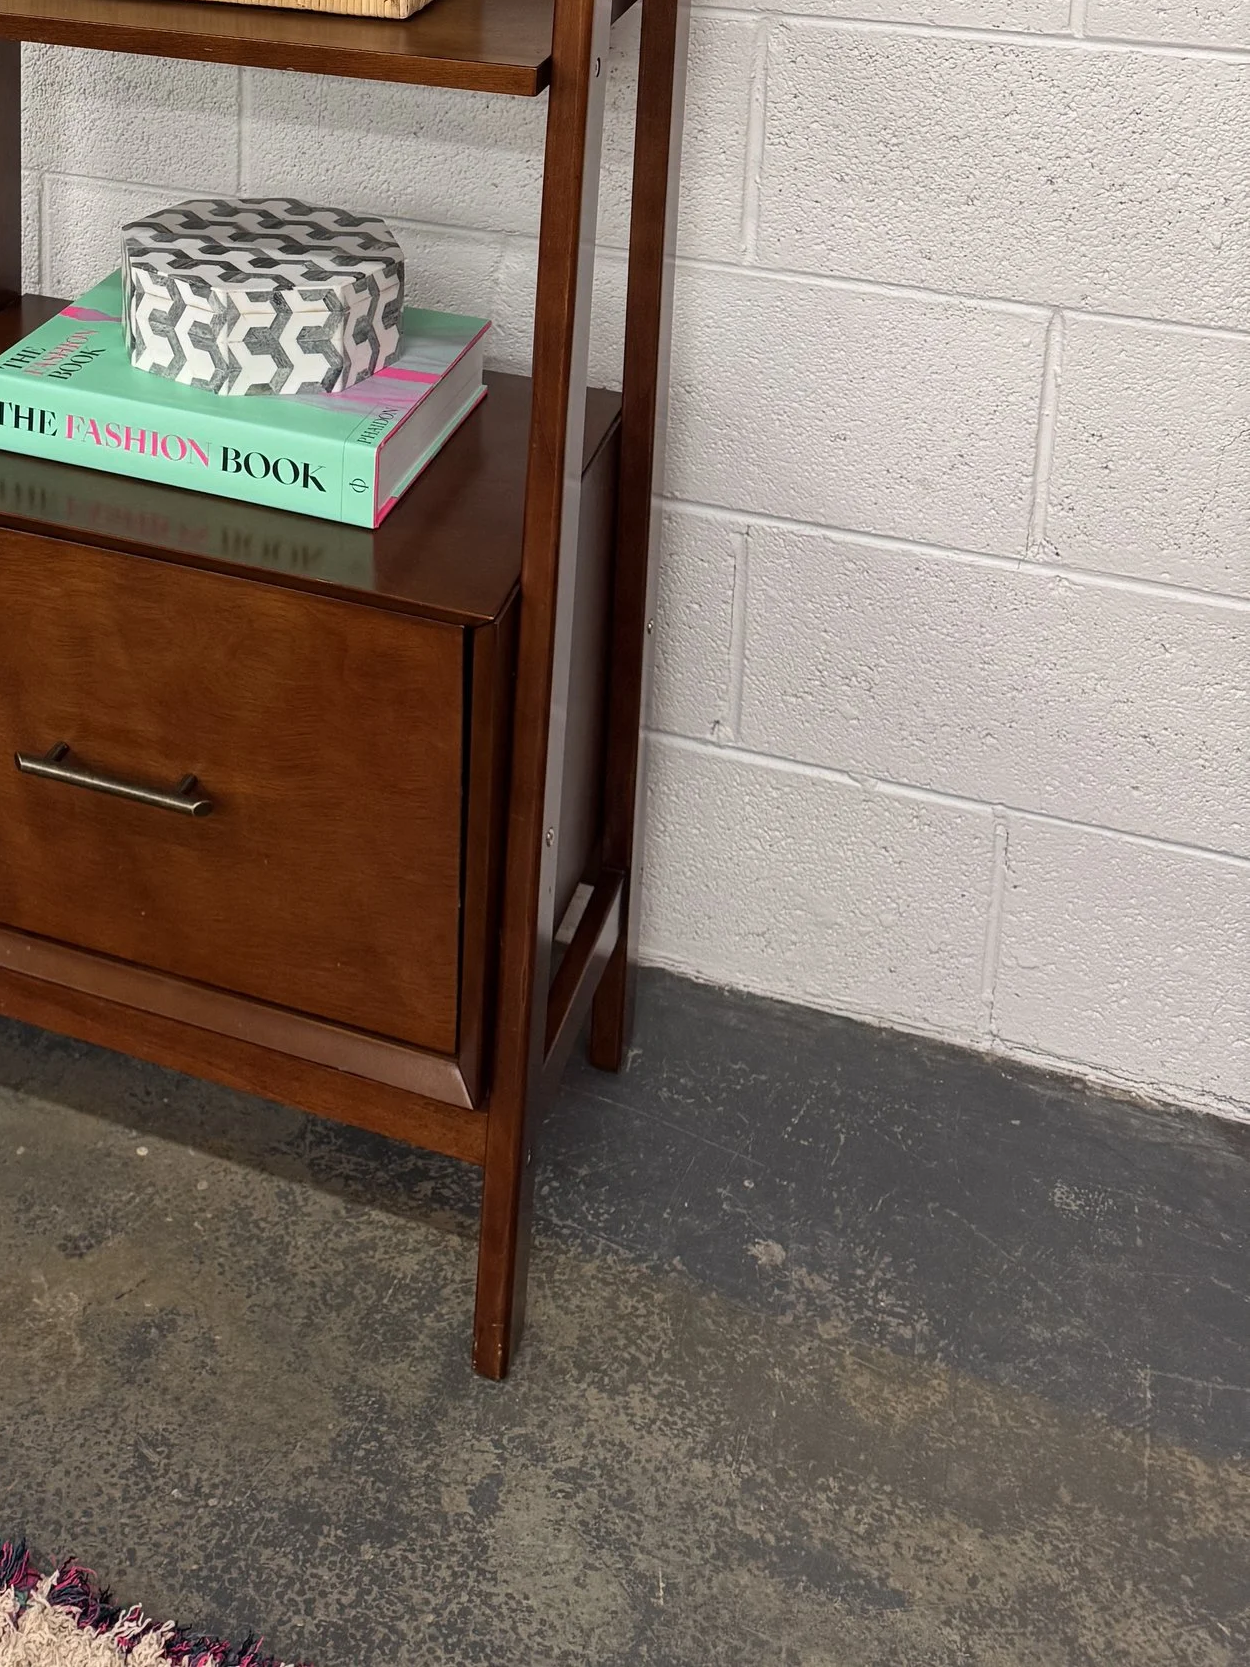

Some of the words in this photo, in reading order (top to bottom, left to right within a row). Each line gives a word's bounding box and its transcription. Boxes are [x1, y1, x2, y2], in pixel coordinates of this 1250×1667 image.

[0, 346, 47, 370] THE
[23, 329, 99, 378] FASHION
[48, 346, 107, 380] BOOK
[356, 407, 398, 444] PHAIDON
[65, 414, 212, 468] FASHION
[220, 445, 327, 493] BOOK
